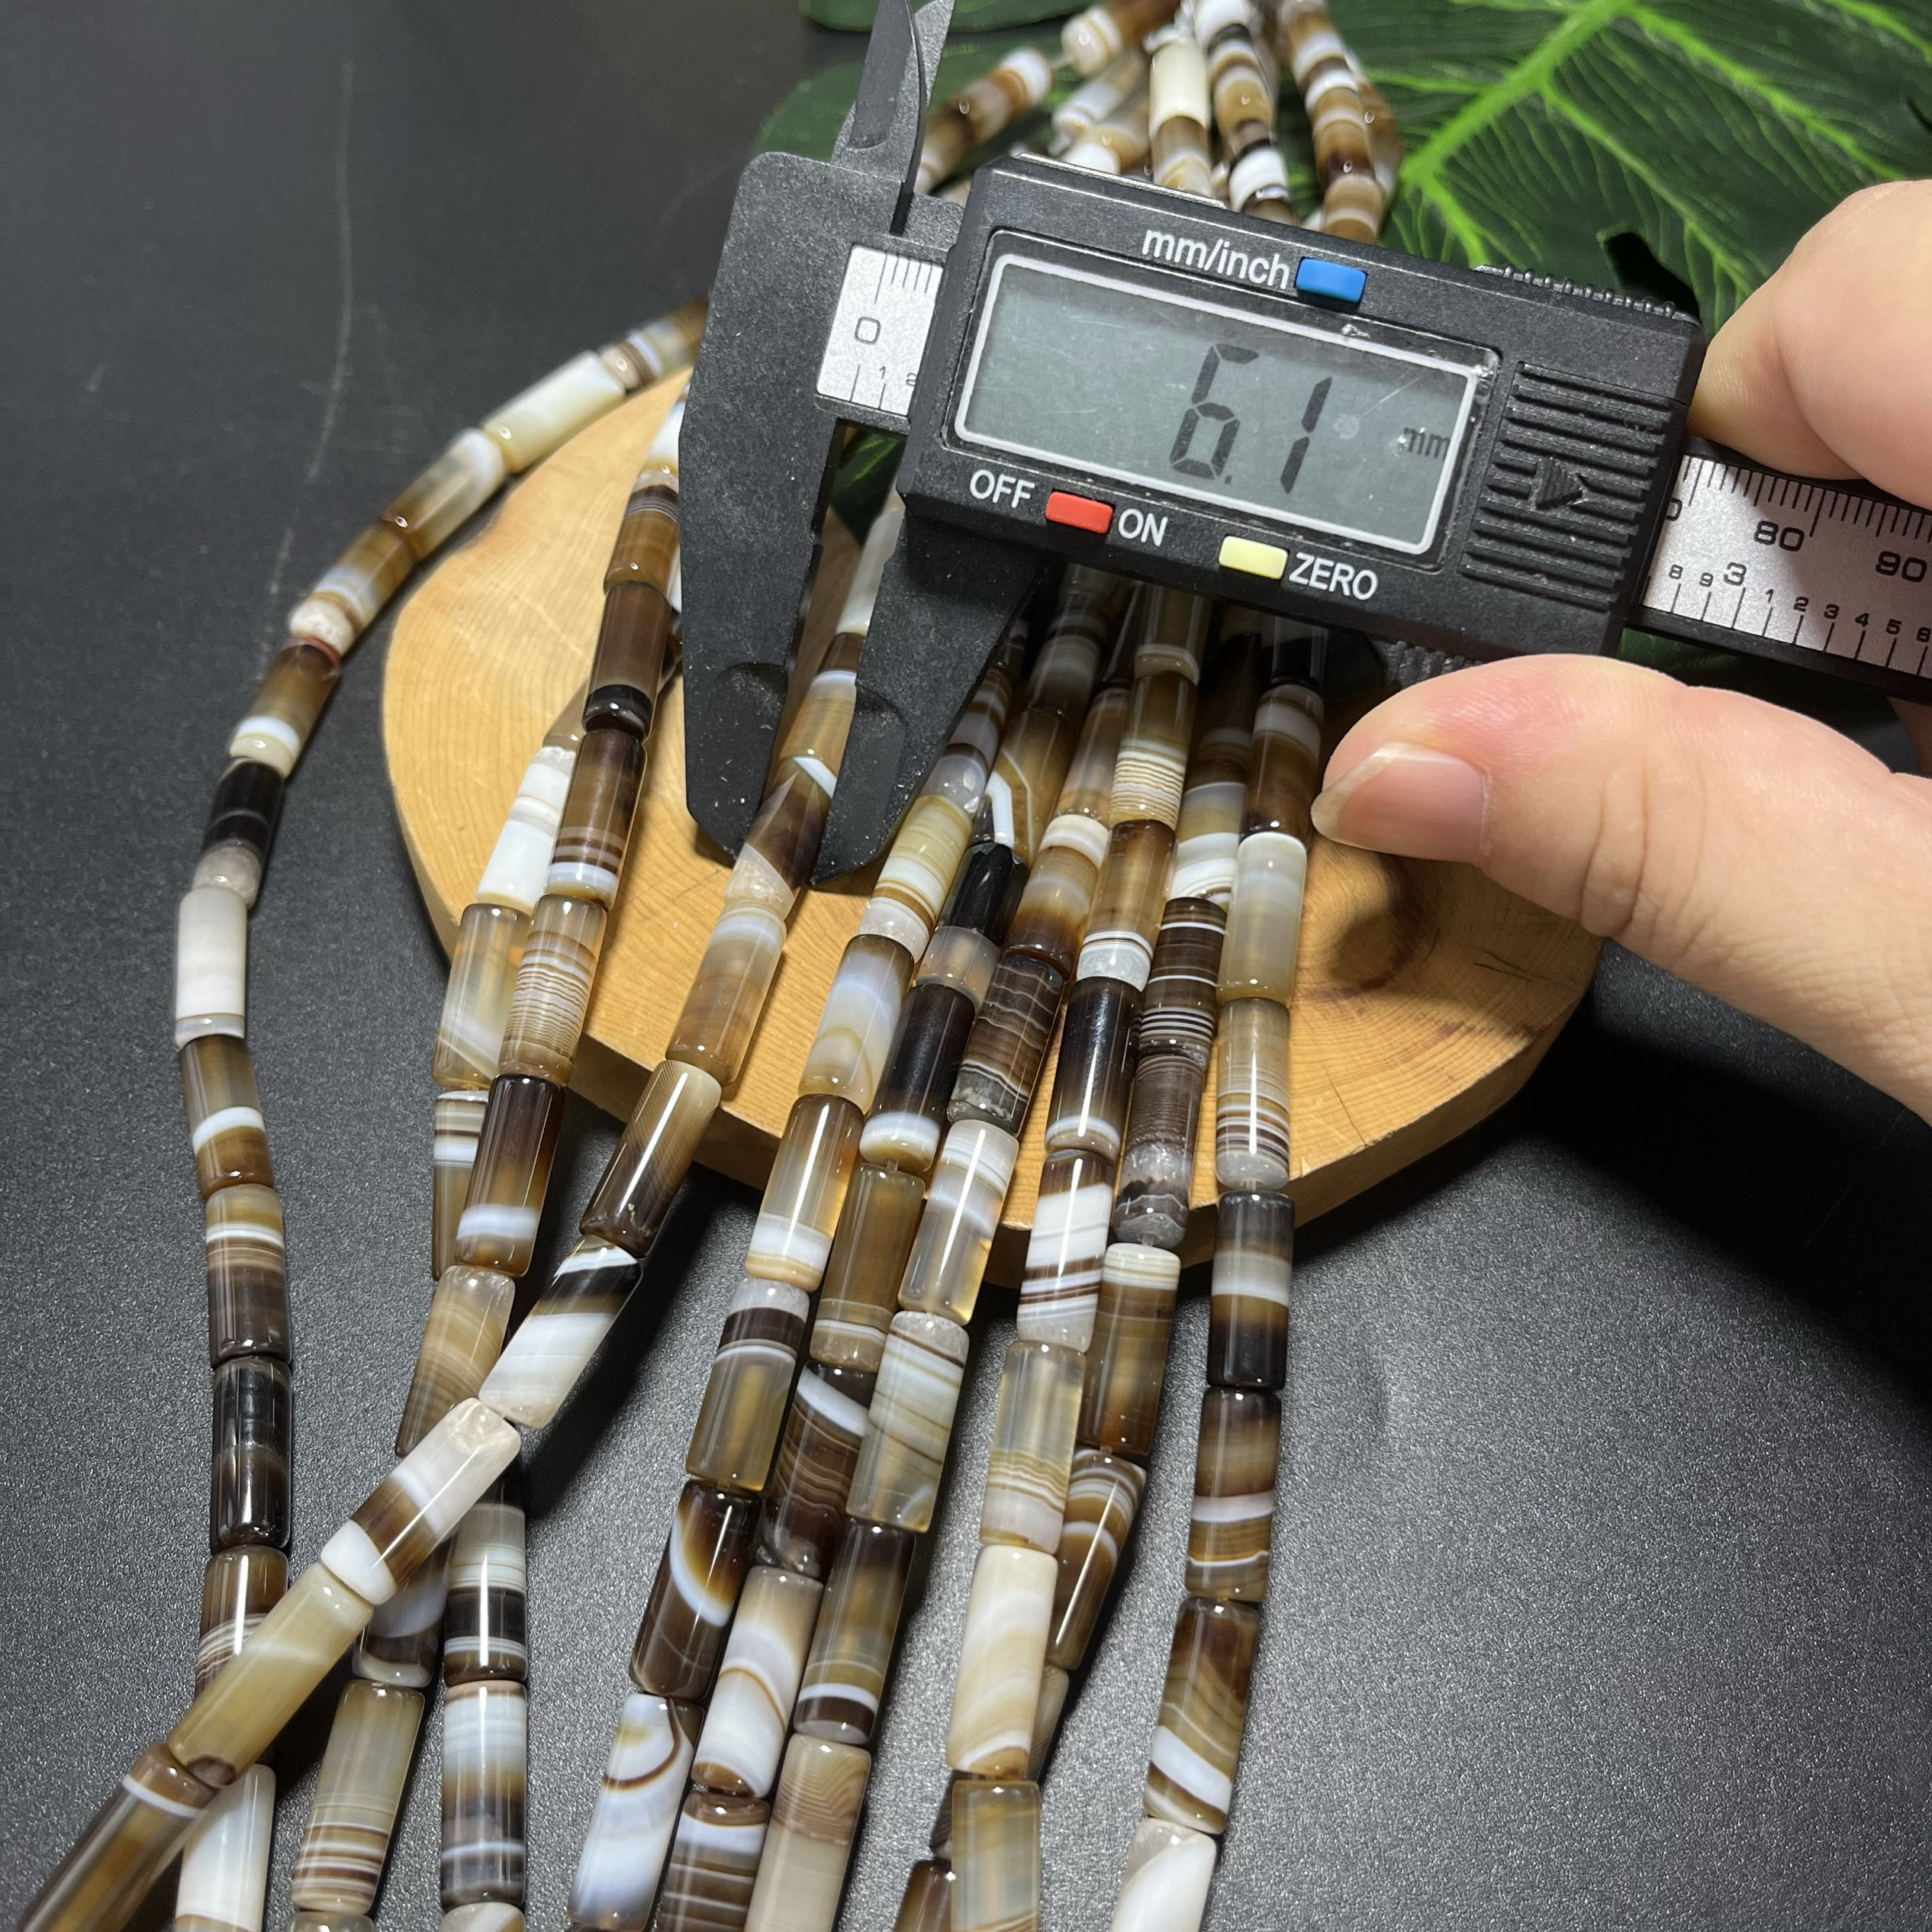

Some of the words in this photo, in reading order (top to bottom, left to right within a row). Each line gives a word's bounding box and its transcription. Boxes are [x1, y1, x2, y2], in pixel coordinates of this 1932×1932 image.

[1142, 230, 1292, 290] mm/inch
[855, 317, 881, 344] 0
[879, 366, 886, 379] 1
[1170, 343, 1332, 495] 6.1
[1403, 427, 1451, 460] mm
[968, 469, 1035, 508] OFF
[1117, 507, 1169, 546] ON
[1288, 552, 1379, 601] ZERO
[1754, 520, 1805, 552] 80
[1875, 551, 1927, 582] 90
[1669, 565, 1683, 580] 8
[1699, 572, 1714, 588] 9
[1724, 562, 1747, 586] 3
[1766, 589, 1774, 603] 1
[1793, 596, 1809, 612] 2
[1824, 604, 1840, 620] 3
[1854, 613, 1869, 627] 4
[1885, 619, 1902, 636] 5
